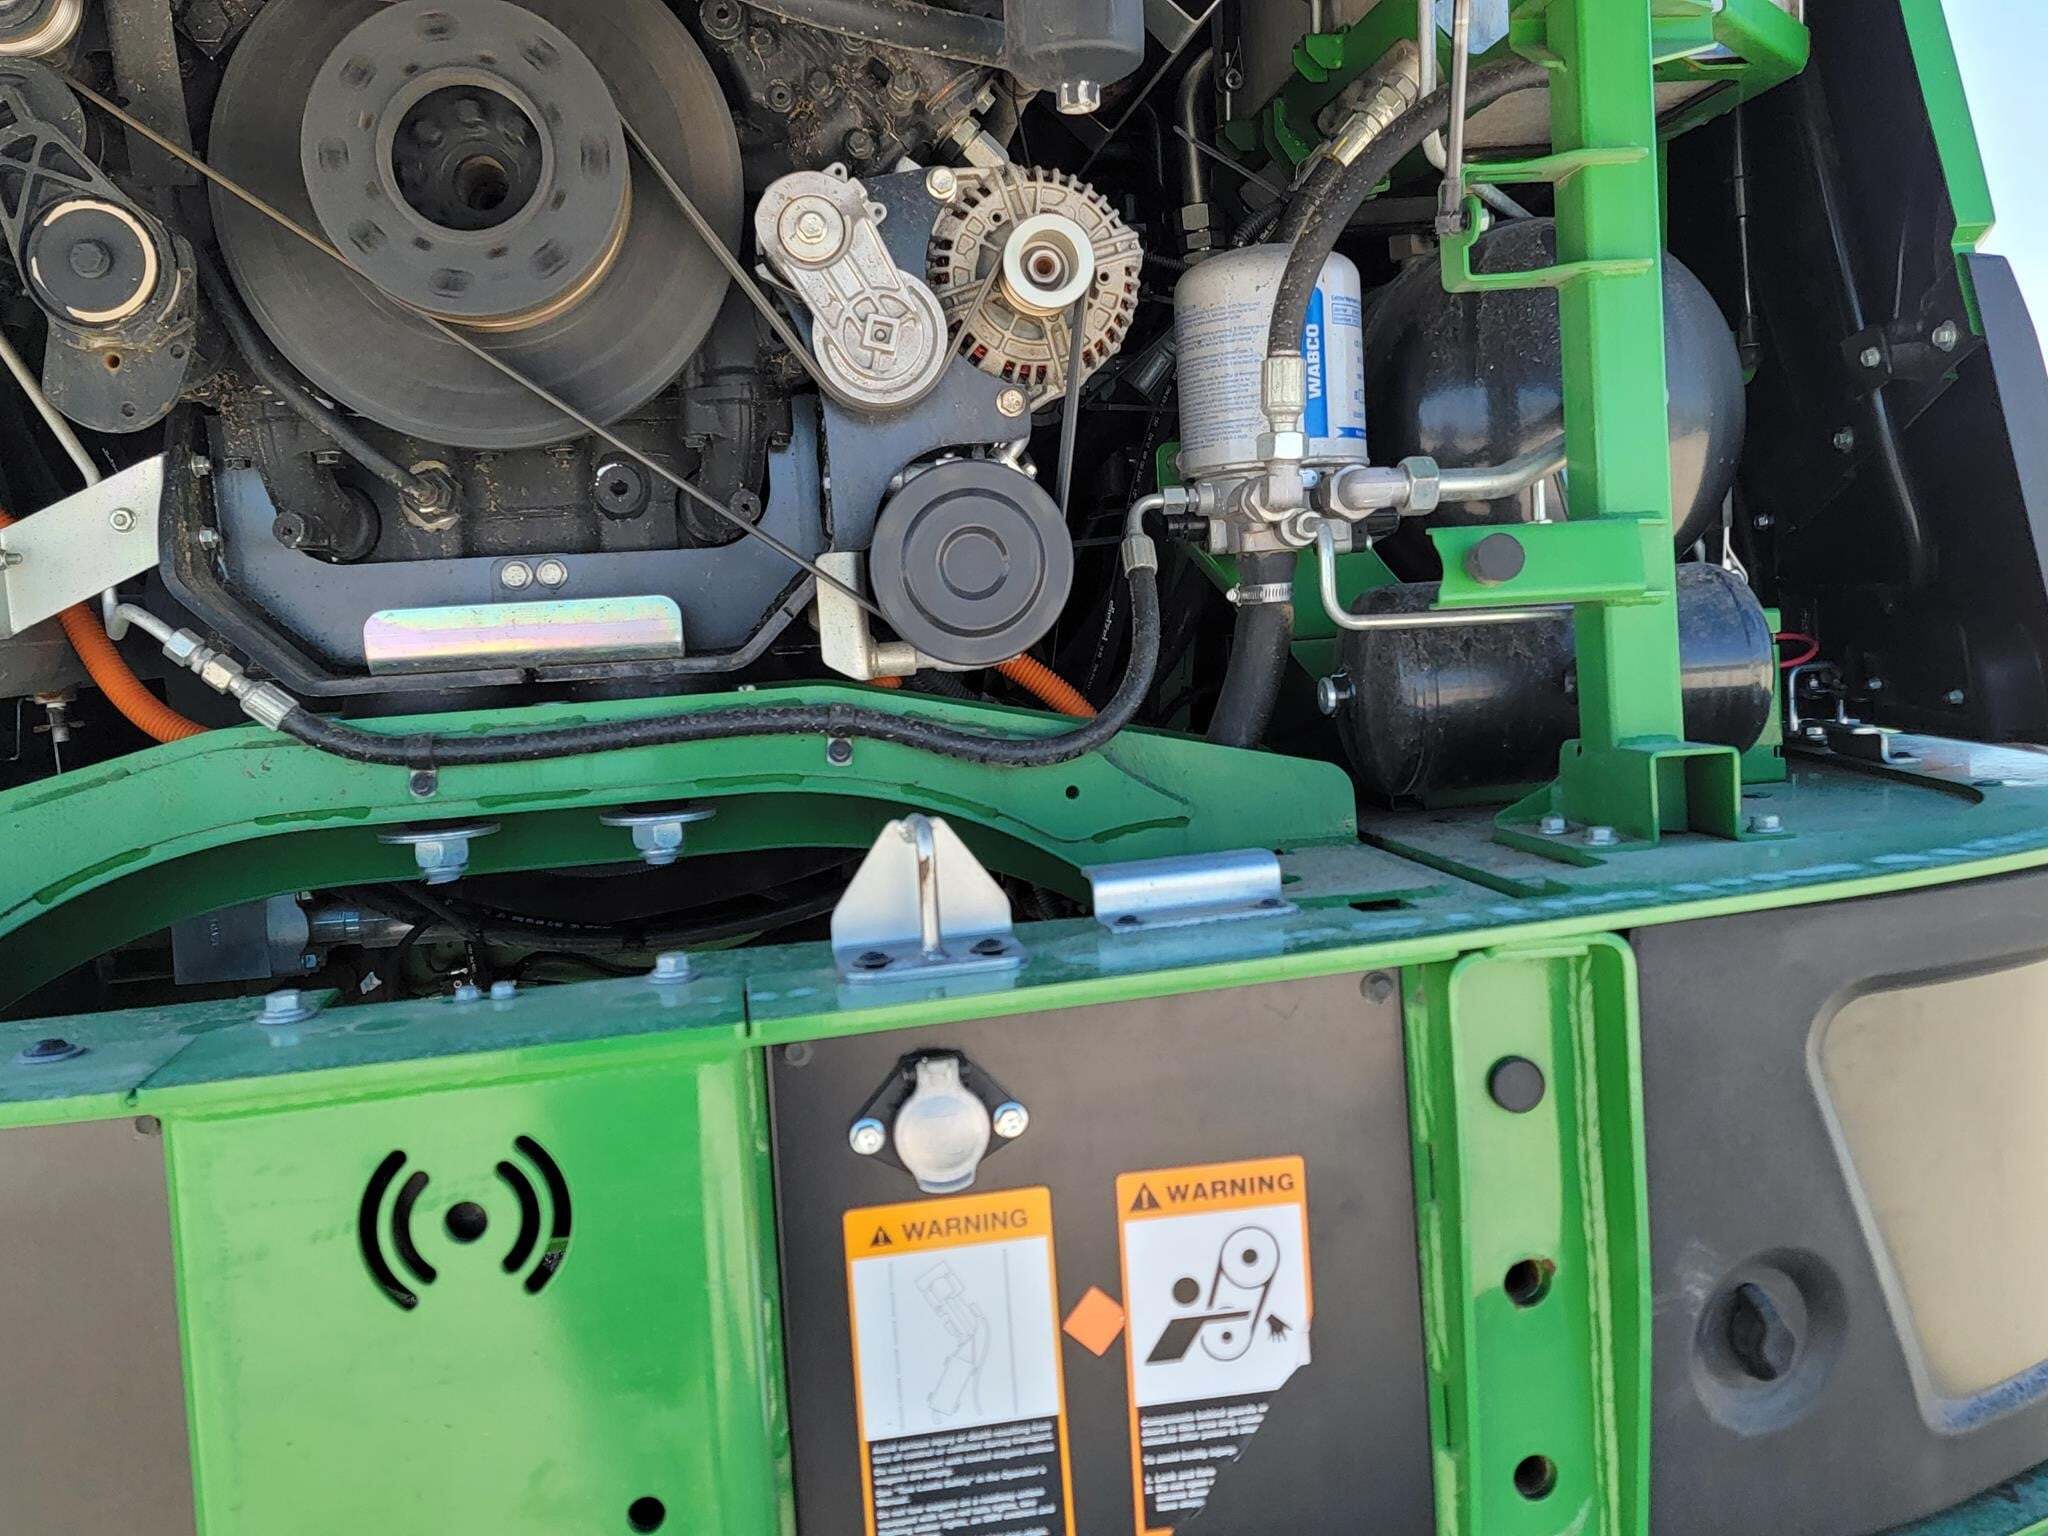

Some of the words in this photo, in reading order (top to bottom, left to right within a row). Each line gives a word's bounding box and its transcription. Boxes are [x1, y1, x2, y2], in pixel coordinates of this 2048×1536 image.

[1306, 324, 1321, 399] WABCO
[1166, 1173, 1294, 1203] WARNING
[902, 1209, 1028, 1242] WARNING
